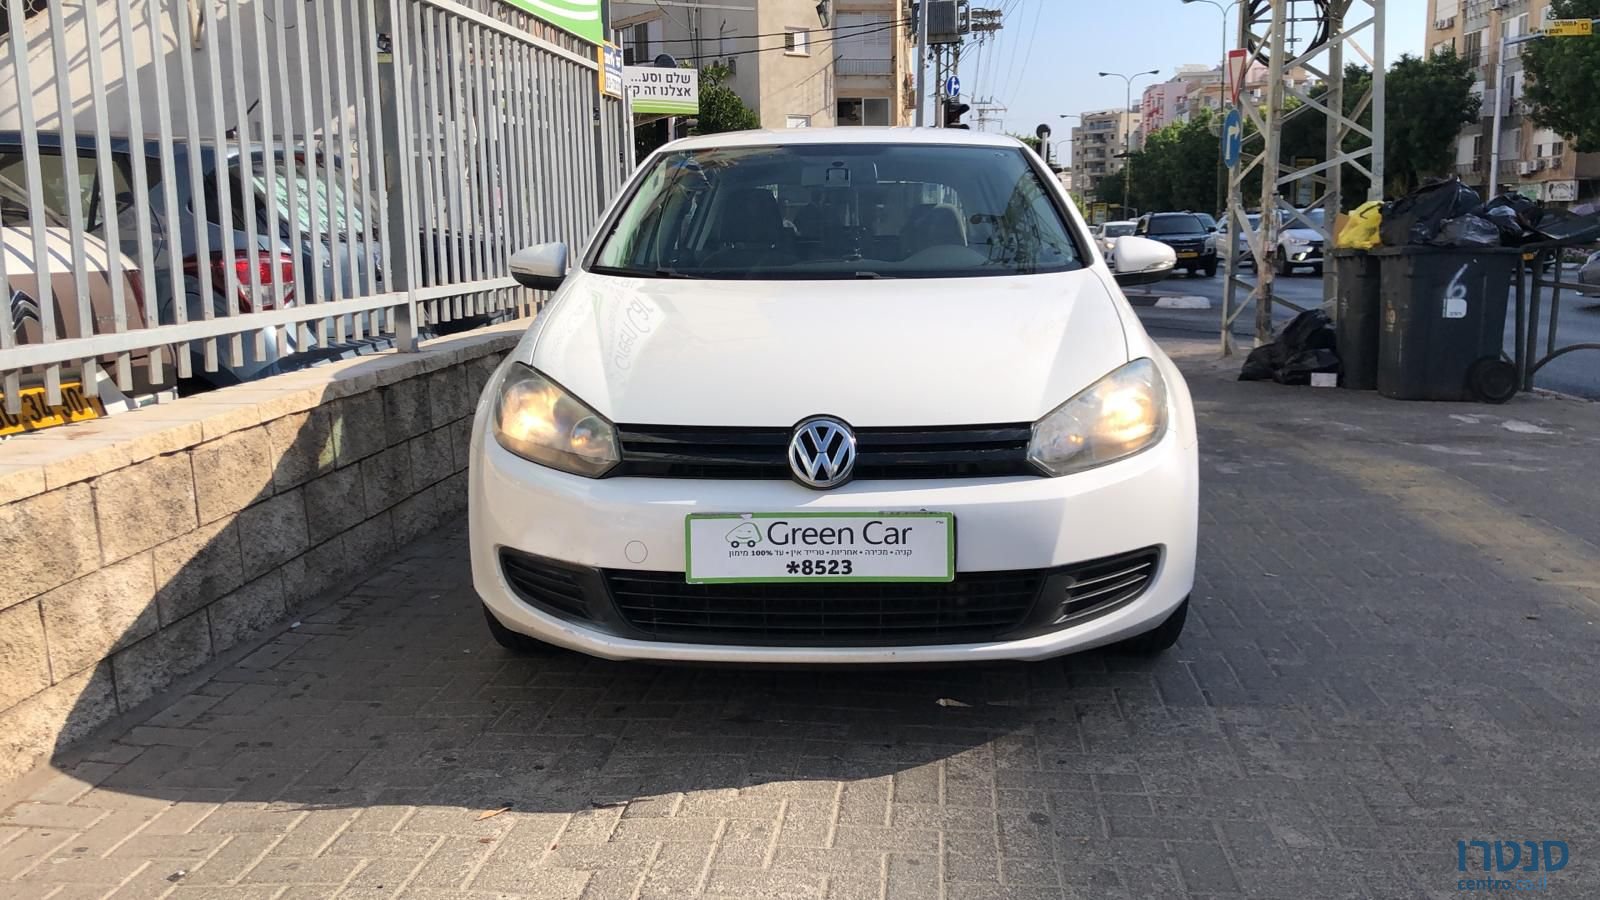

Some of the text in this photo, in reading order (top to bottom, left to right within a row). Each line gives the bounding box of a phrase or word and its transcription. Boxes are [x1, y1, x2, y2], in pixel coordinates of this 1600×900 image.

[631, 72, 691, 84] שלם וסע...
[644, 85, 657, 95] זה
[660, 84, 692, 97] אצלנו
[1446, 263, 1468, 300] 6
[791, 419, 853, 486] VW
[767, 520, 913, 546] Green Car
[728, 549, 749, 558] מימון
[774, 549, 784, 557] עד
[790, 549, 802, 558] אין
[894, 549, 913, 558] קניה
